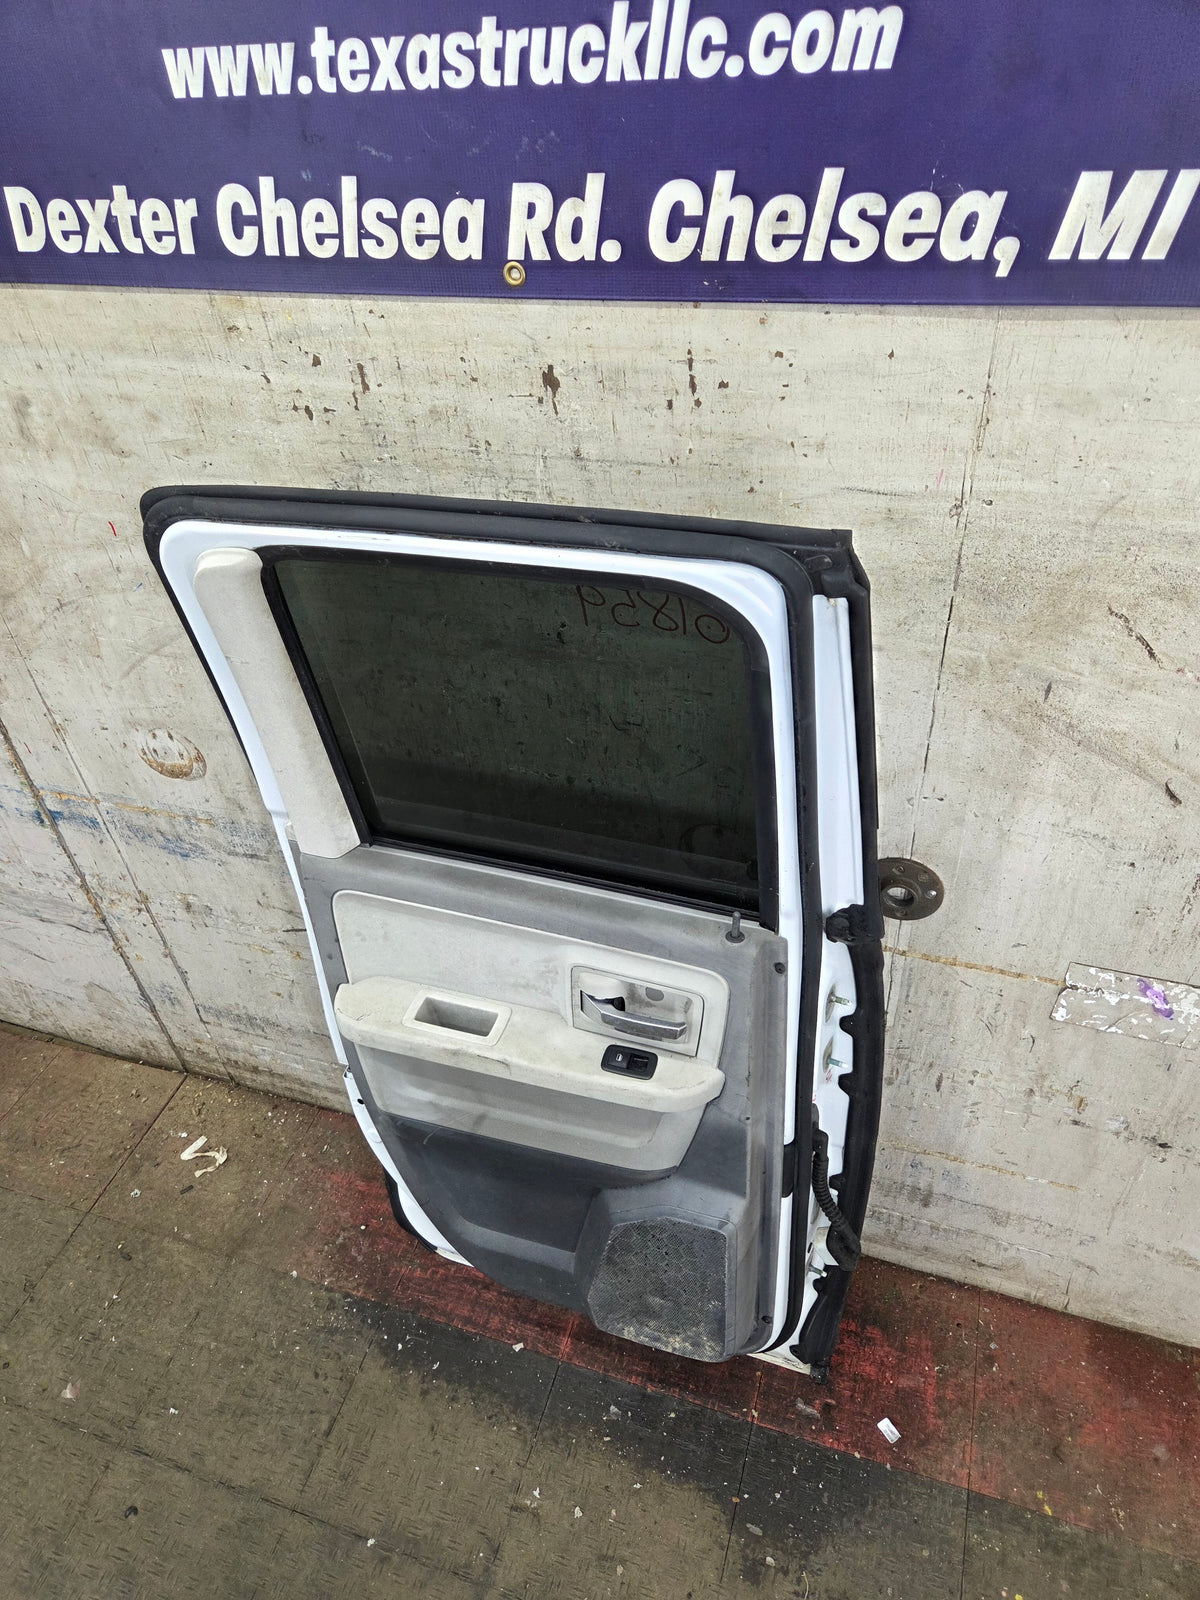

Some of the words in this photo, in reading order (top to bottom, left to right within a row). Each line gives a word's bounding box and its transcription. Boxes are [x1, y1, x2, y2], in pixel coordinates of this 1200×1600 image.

[159, 0, 904, 100] www.texastruckllc.com
[3, 184, 199, 256] Dexter
[215, 175, 486, 261] Chelsea
[506, 172, 622, 263] Rd.
[647, 166, 1021, 278] Chelsea,
[1047, 168, 1200, 261] MI
